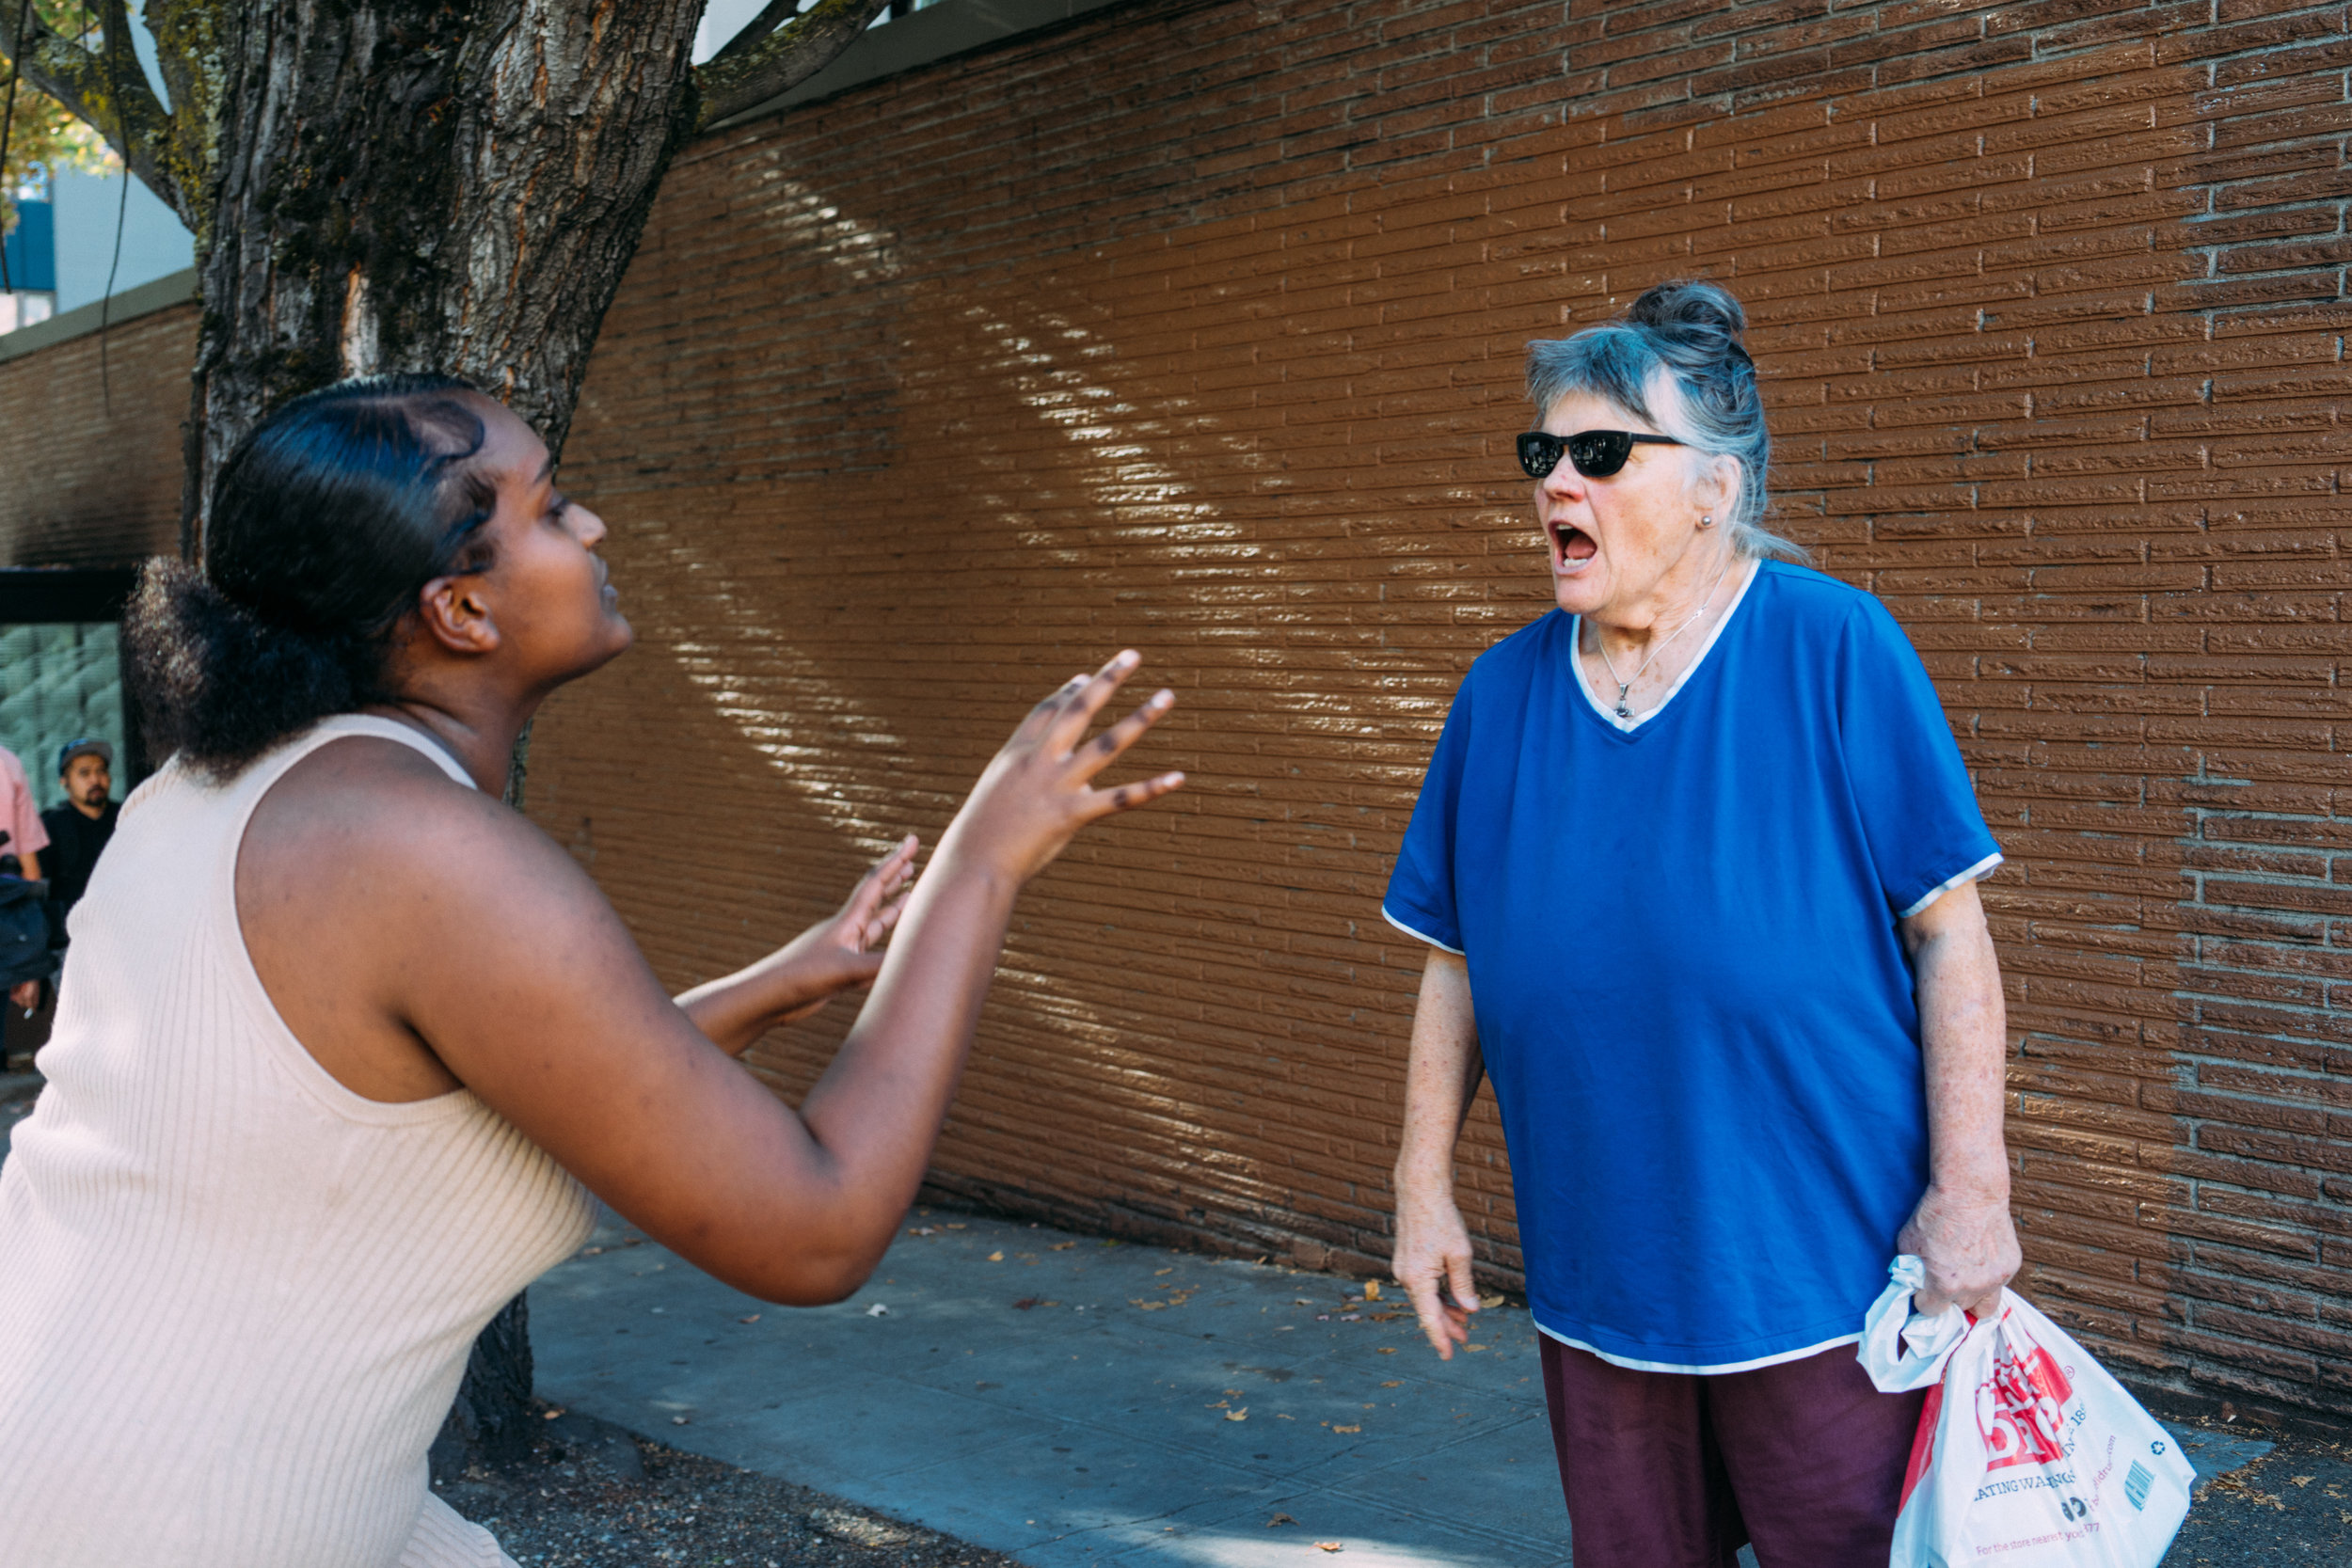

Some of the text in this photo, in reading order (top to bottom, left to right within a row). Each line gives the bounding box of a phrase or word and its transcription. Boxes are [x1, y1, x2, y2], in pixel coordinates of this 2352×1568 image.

[1974, 1480, 2018, 1502] ATING
[1976, 1545, 1992, 1557] For
[1993, 1541, 2010, 1552] the
[2010, 1536, 2031, 1550] store
[2031, 1531, 2063, 1544] nearest
